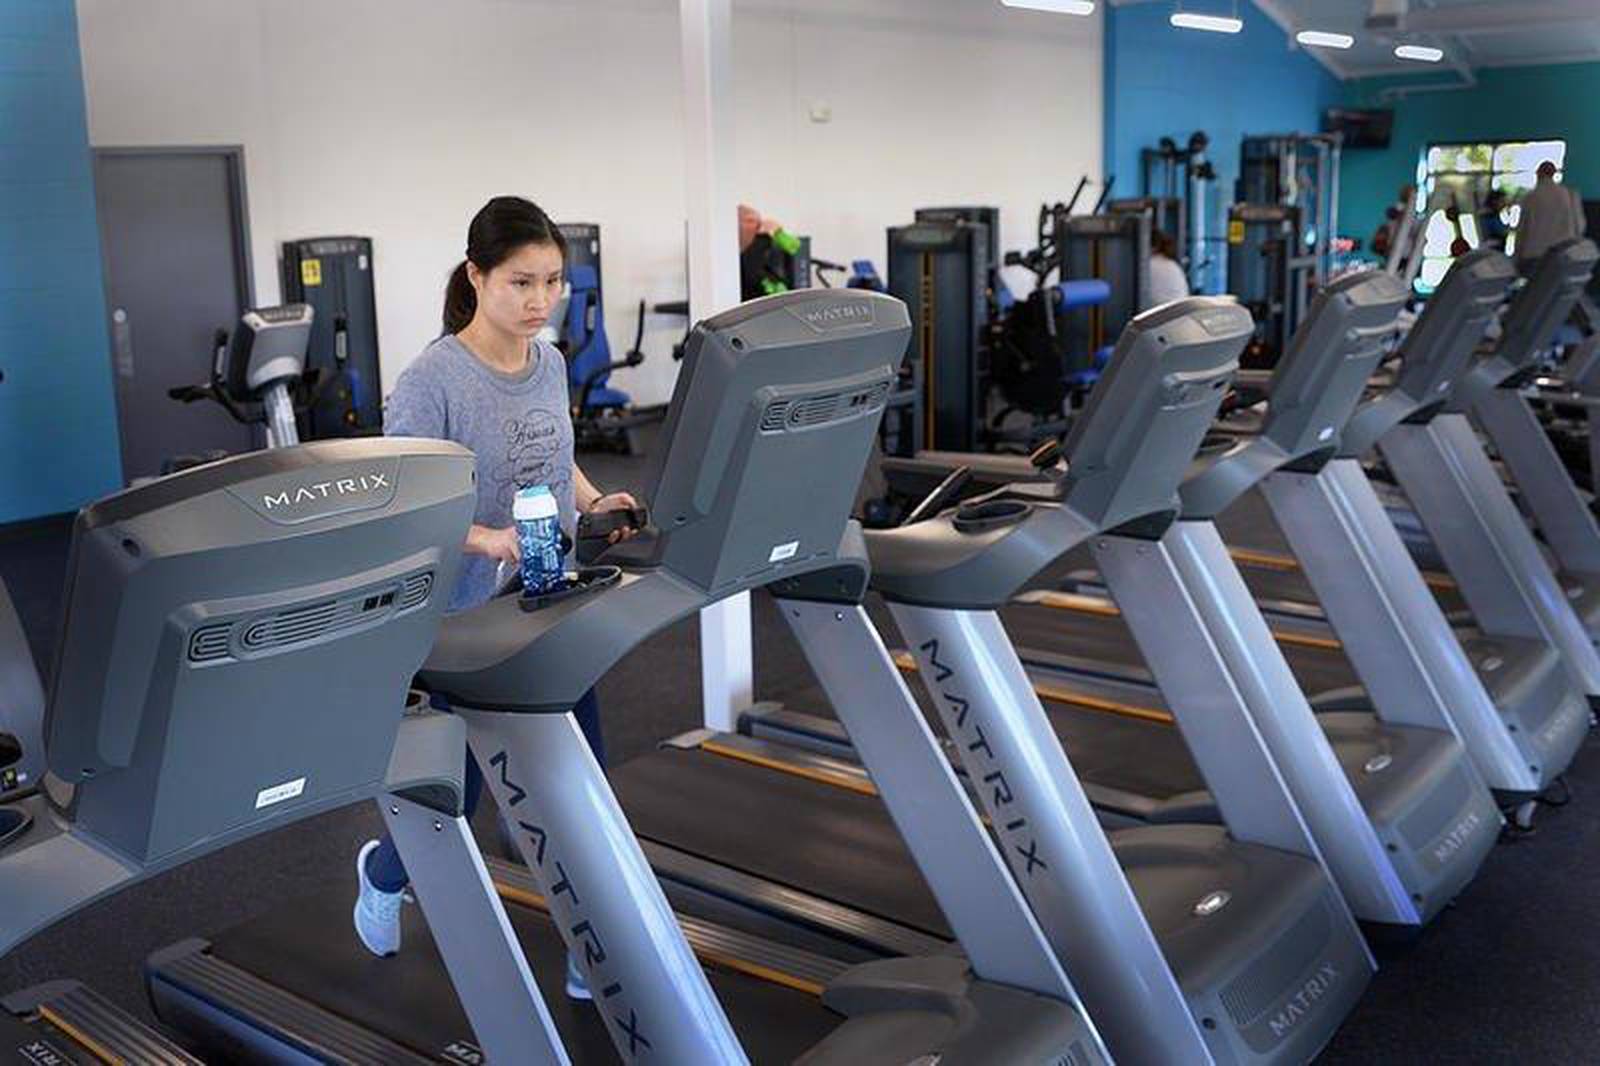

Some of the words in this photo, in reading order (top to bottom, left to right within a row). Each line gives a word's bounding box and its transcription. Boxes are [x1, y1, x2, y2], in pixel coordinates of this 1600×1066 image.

[263, 474, 388, 508] MATRIX
[920, 639, 1047, 873] MATRIX
[490, 752, 651, 1055] MATRIX
[1269, 961, 1335, 1037] MATRIX
